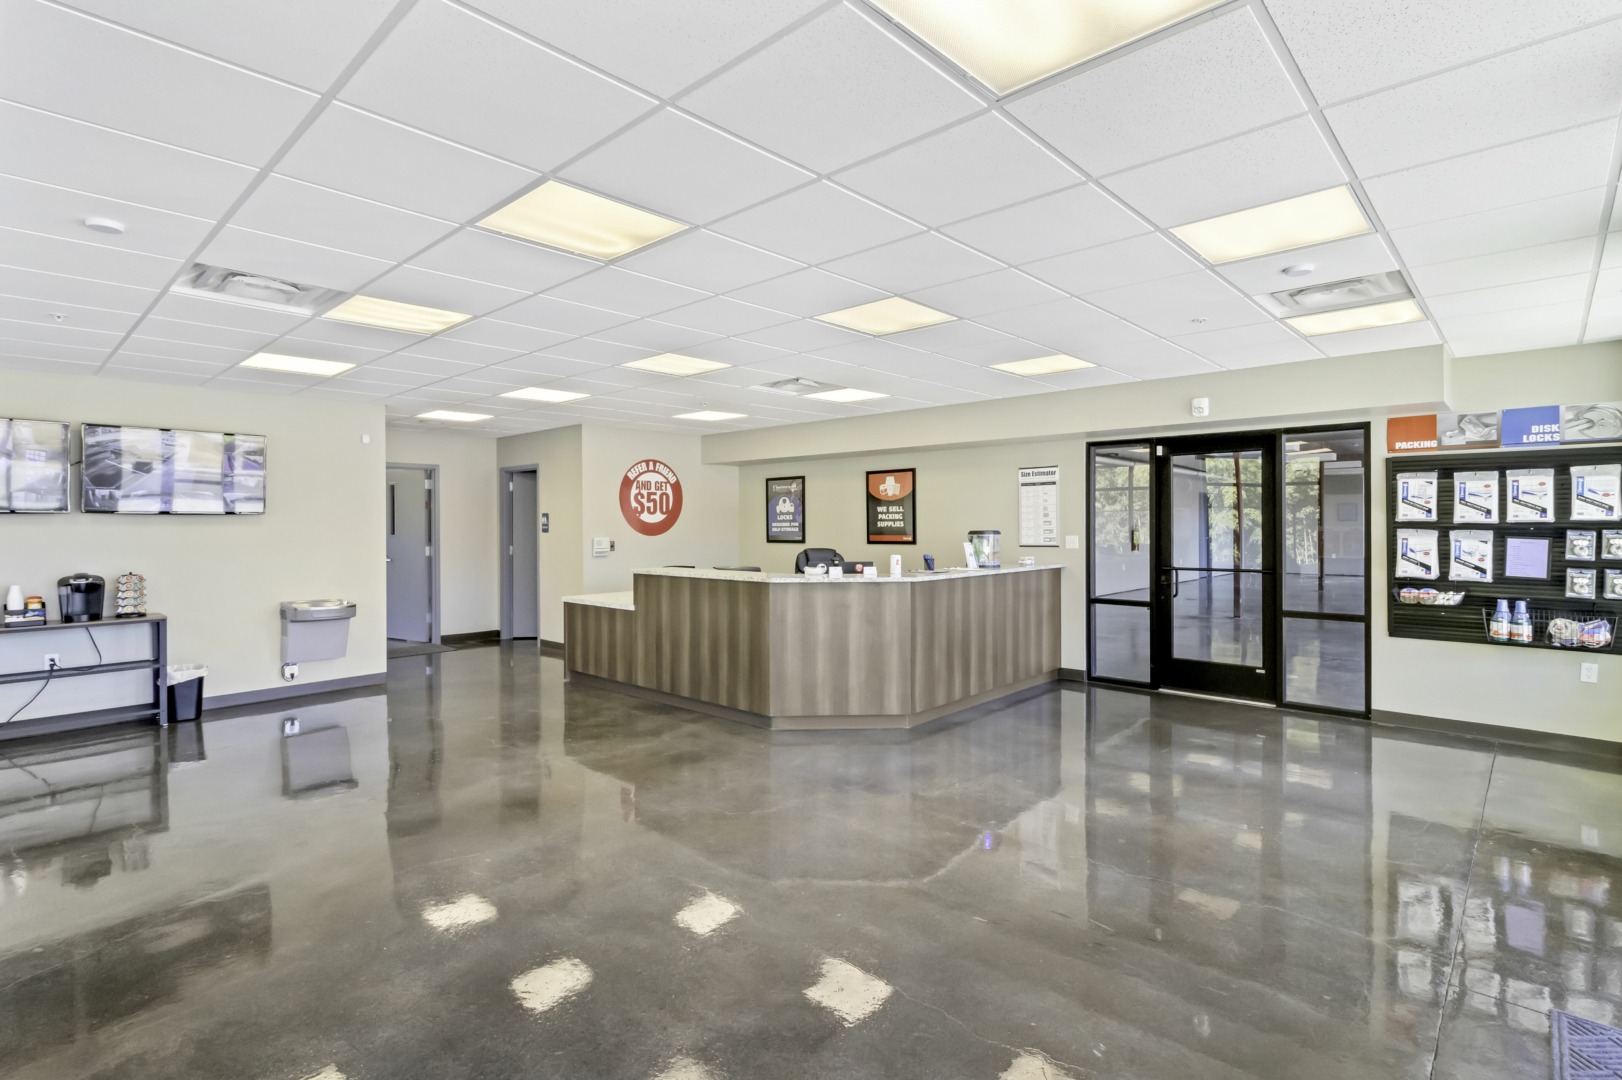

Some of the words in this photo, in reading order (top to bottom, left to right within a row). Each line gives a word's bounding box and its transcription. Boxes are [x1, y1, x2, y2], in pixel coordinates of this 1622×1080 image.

[1532, 424, 1559, 433] DISK
[1522, 434, 1560, 443] LOCKS
[1395, 440, 1437, 449] PACKING
[627, 462, 647, 480] REFER
[649, 461, 654, 471] A
[656, 462, 677, 484] FRIEND
[635, 480, 652, 491] AND
[654, 481, 667, 491] GET
[633, 489, 670, 516] $50
